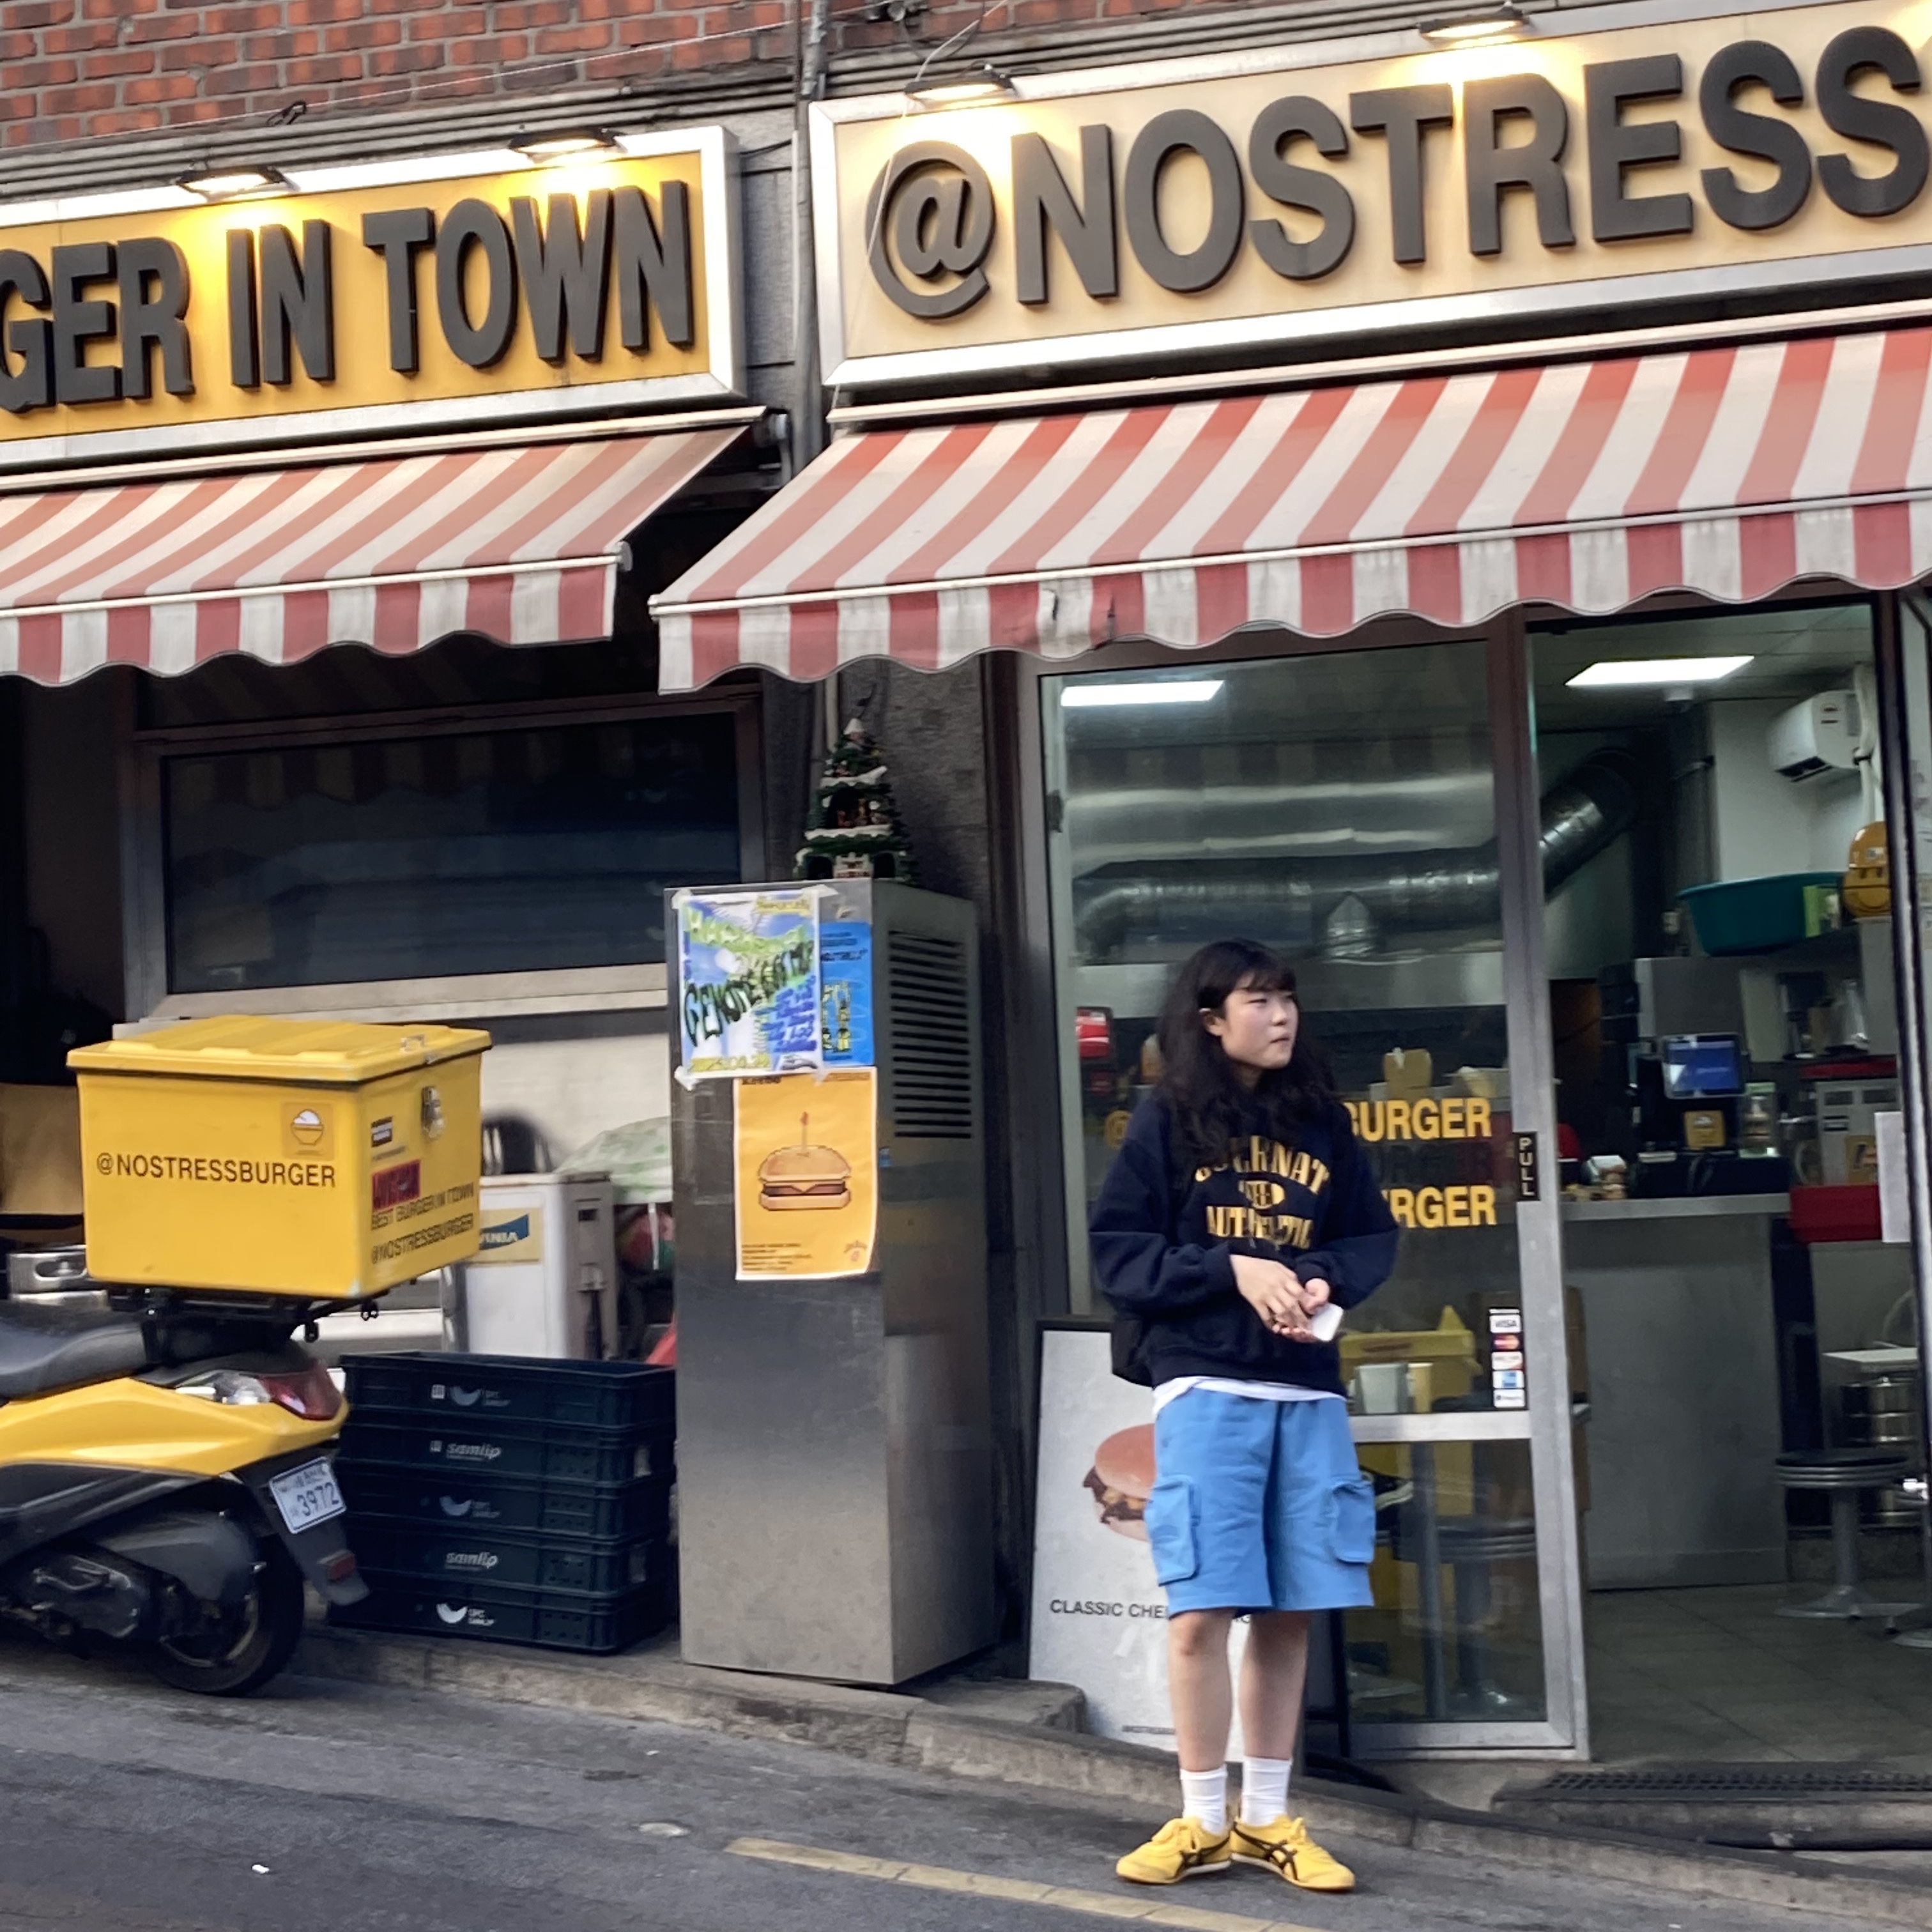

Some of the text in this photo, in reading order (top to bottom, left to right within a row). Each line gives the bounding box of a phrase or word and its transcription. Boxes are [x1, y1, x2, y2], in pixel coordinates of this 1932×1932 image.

[865, 25, 1930, 319] @NOSTRESS
[0, 180, 694, 414] GER IN TOWN
[96, 1152, 336, 1188] @NOSTRESSBURGER
[1519, 1137, 1535, 1197] PULL
[1381, 1184, 1497, 1229] RGER
[296, 1481, 340, 1517] 3972
[1050, 1599, 1123, 1618] CLASSIC
